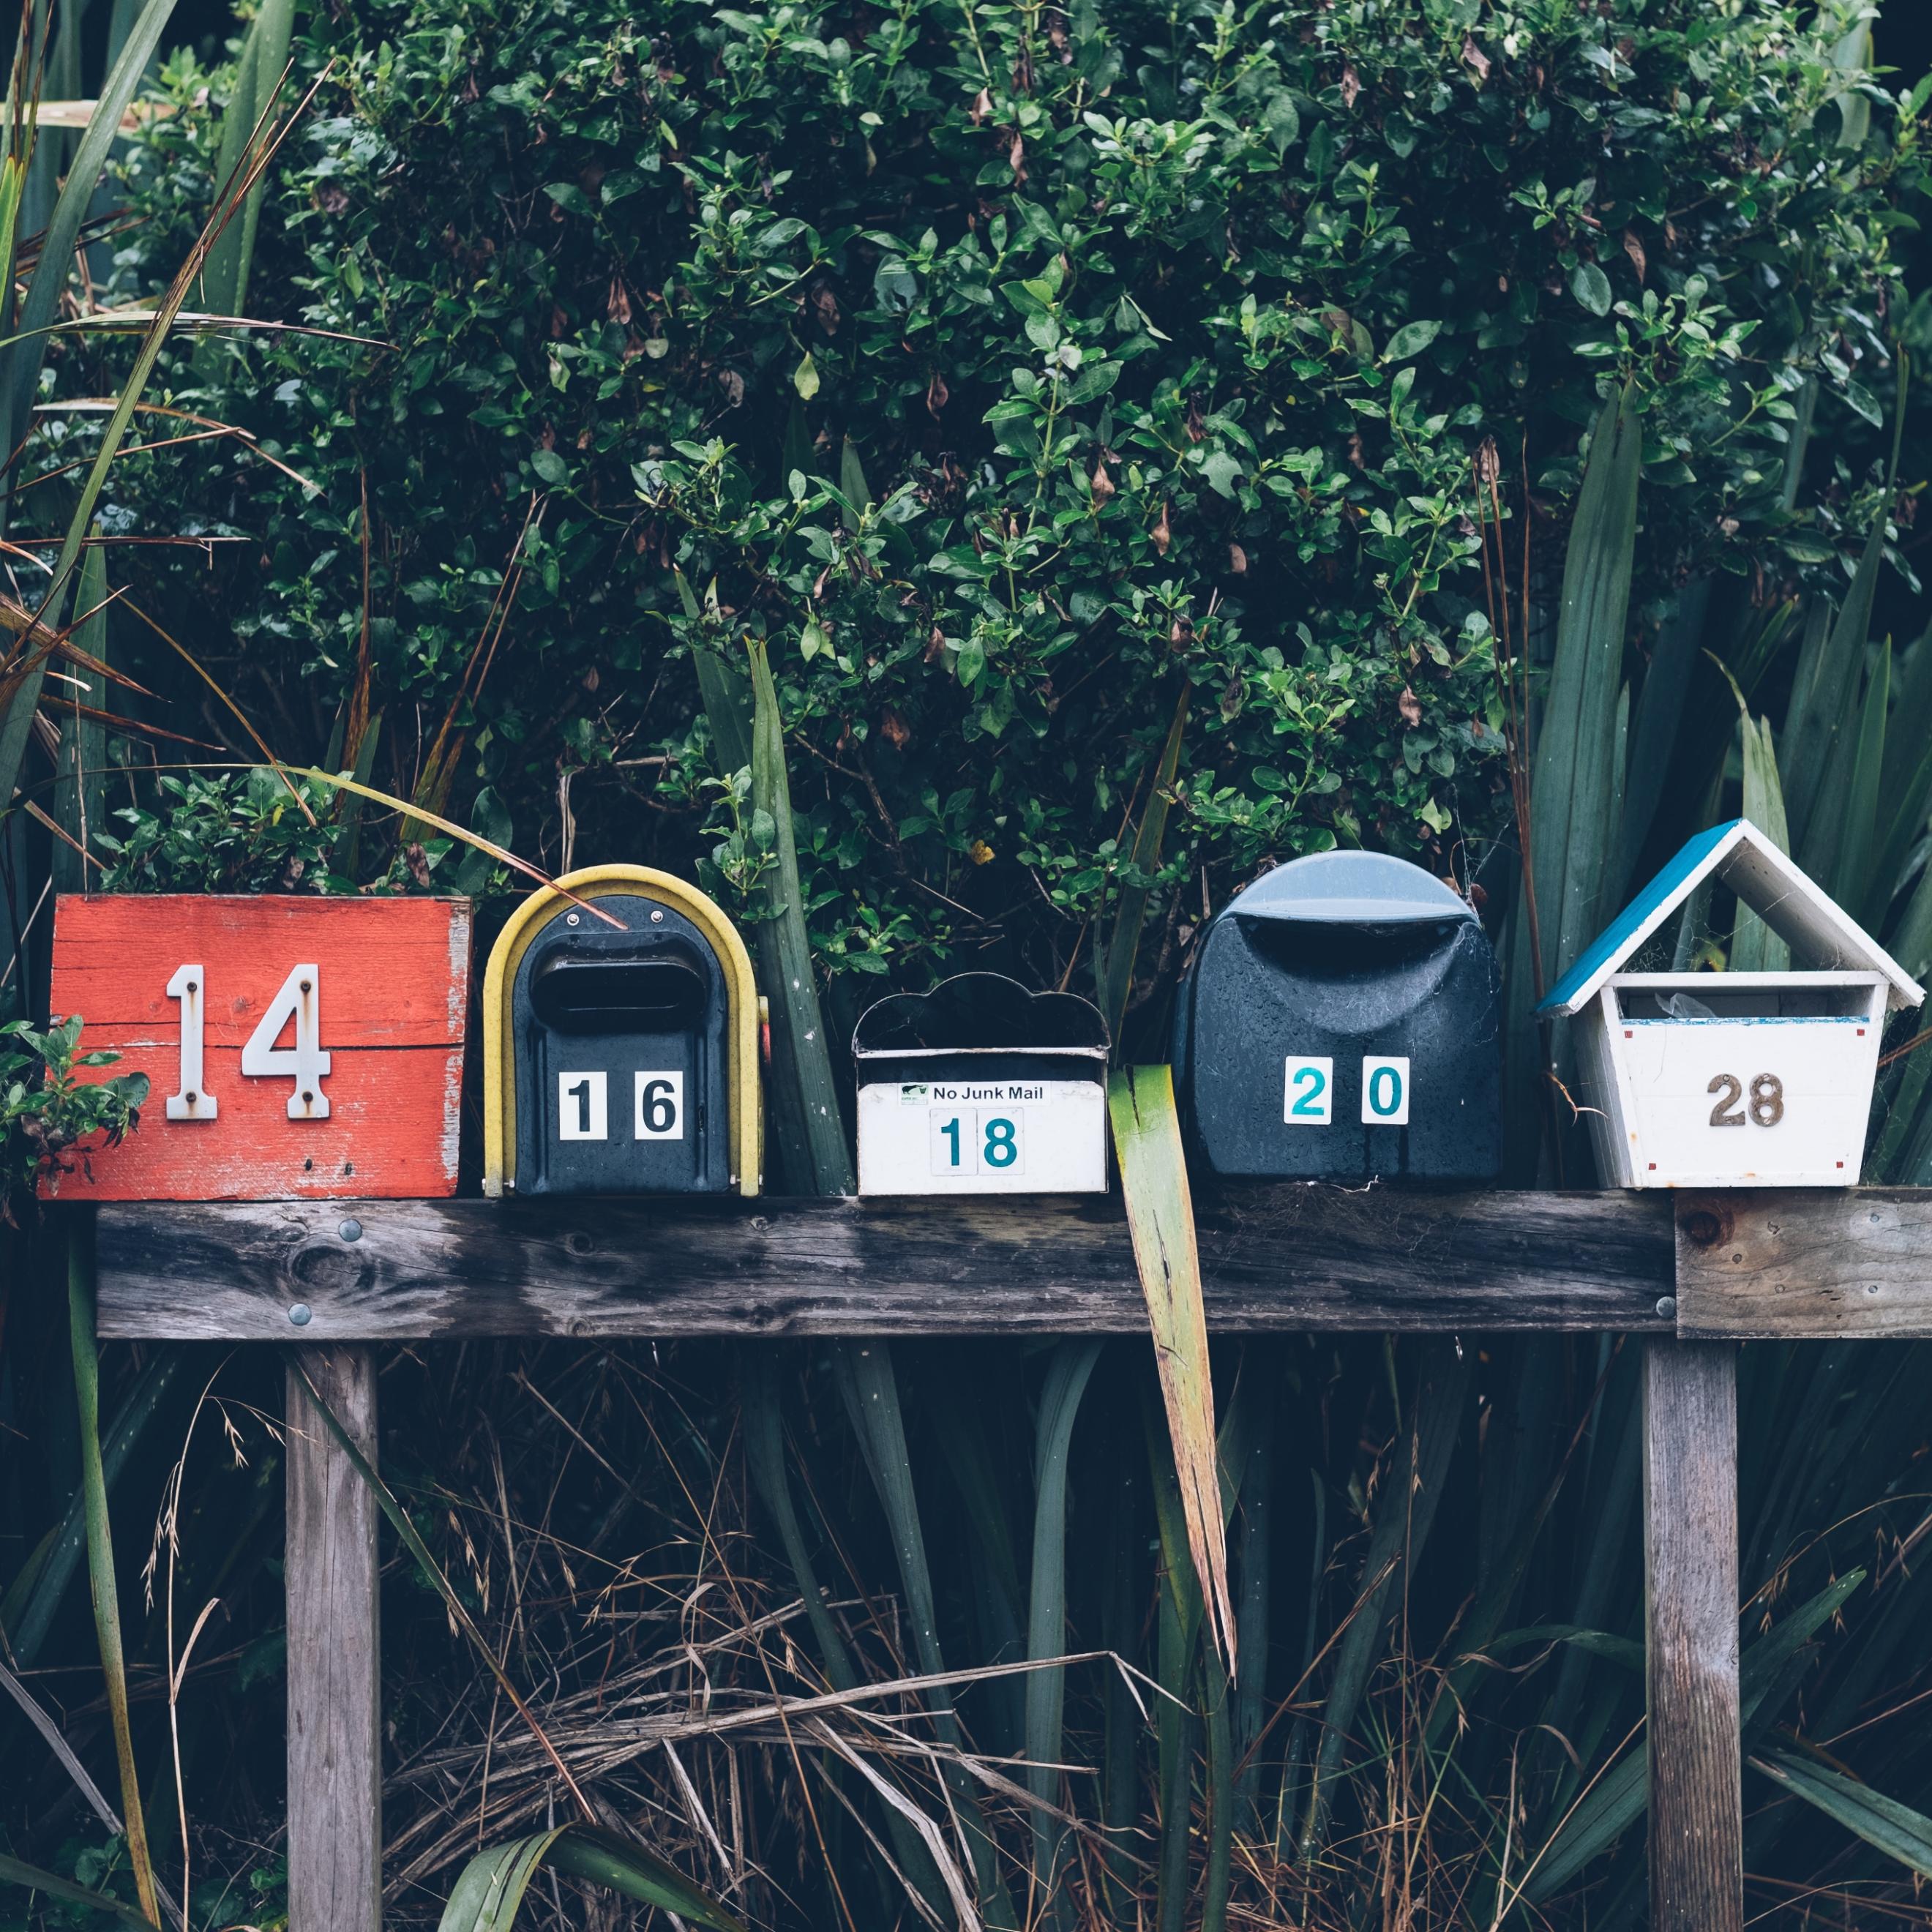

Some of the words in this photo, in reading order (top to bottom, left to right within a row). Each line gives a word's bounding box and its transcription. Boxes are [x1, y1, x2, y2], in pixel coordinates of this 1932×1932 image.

[165, 962, 332, 1120] 14
[933, 1087, 957, 1100] No
[961, 1087, 1003, 1100] Junk
[1008, 1087, 1044, 1100] Mail
[1707, 1073, 1785, 1128] 28
[940, 1117, 1018, 1168] 18
